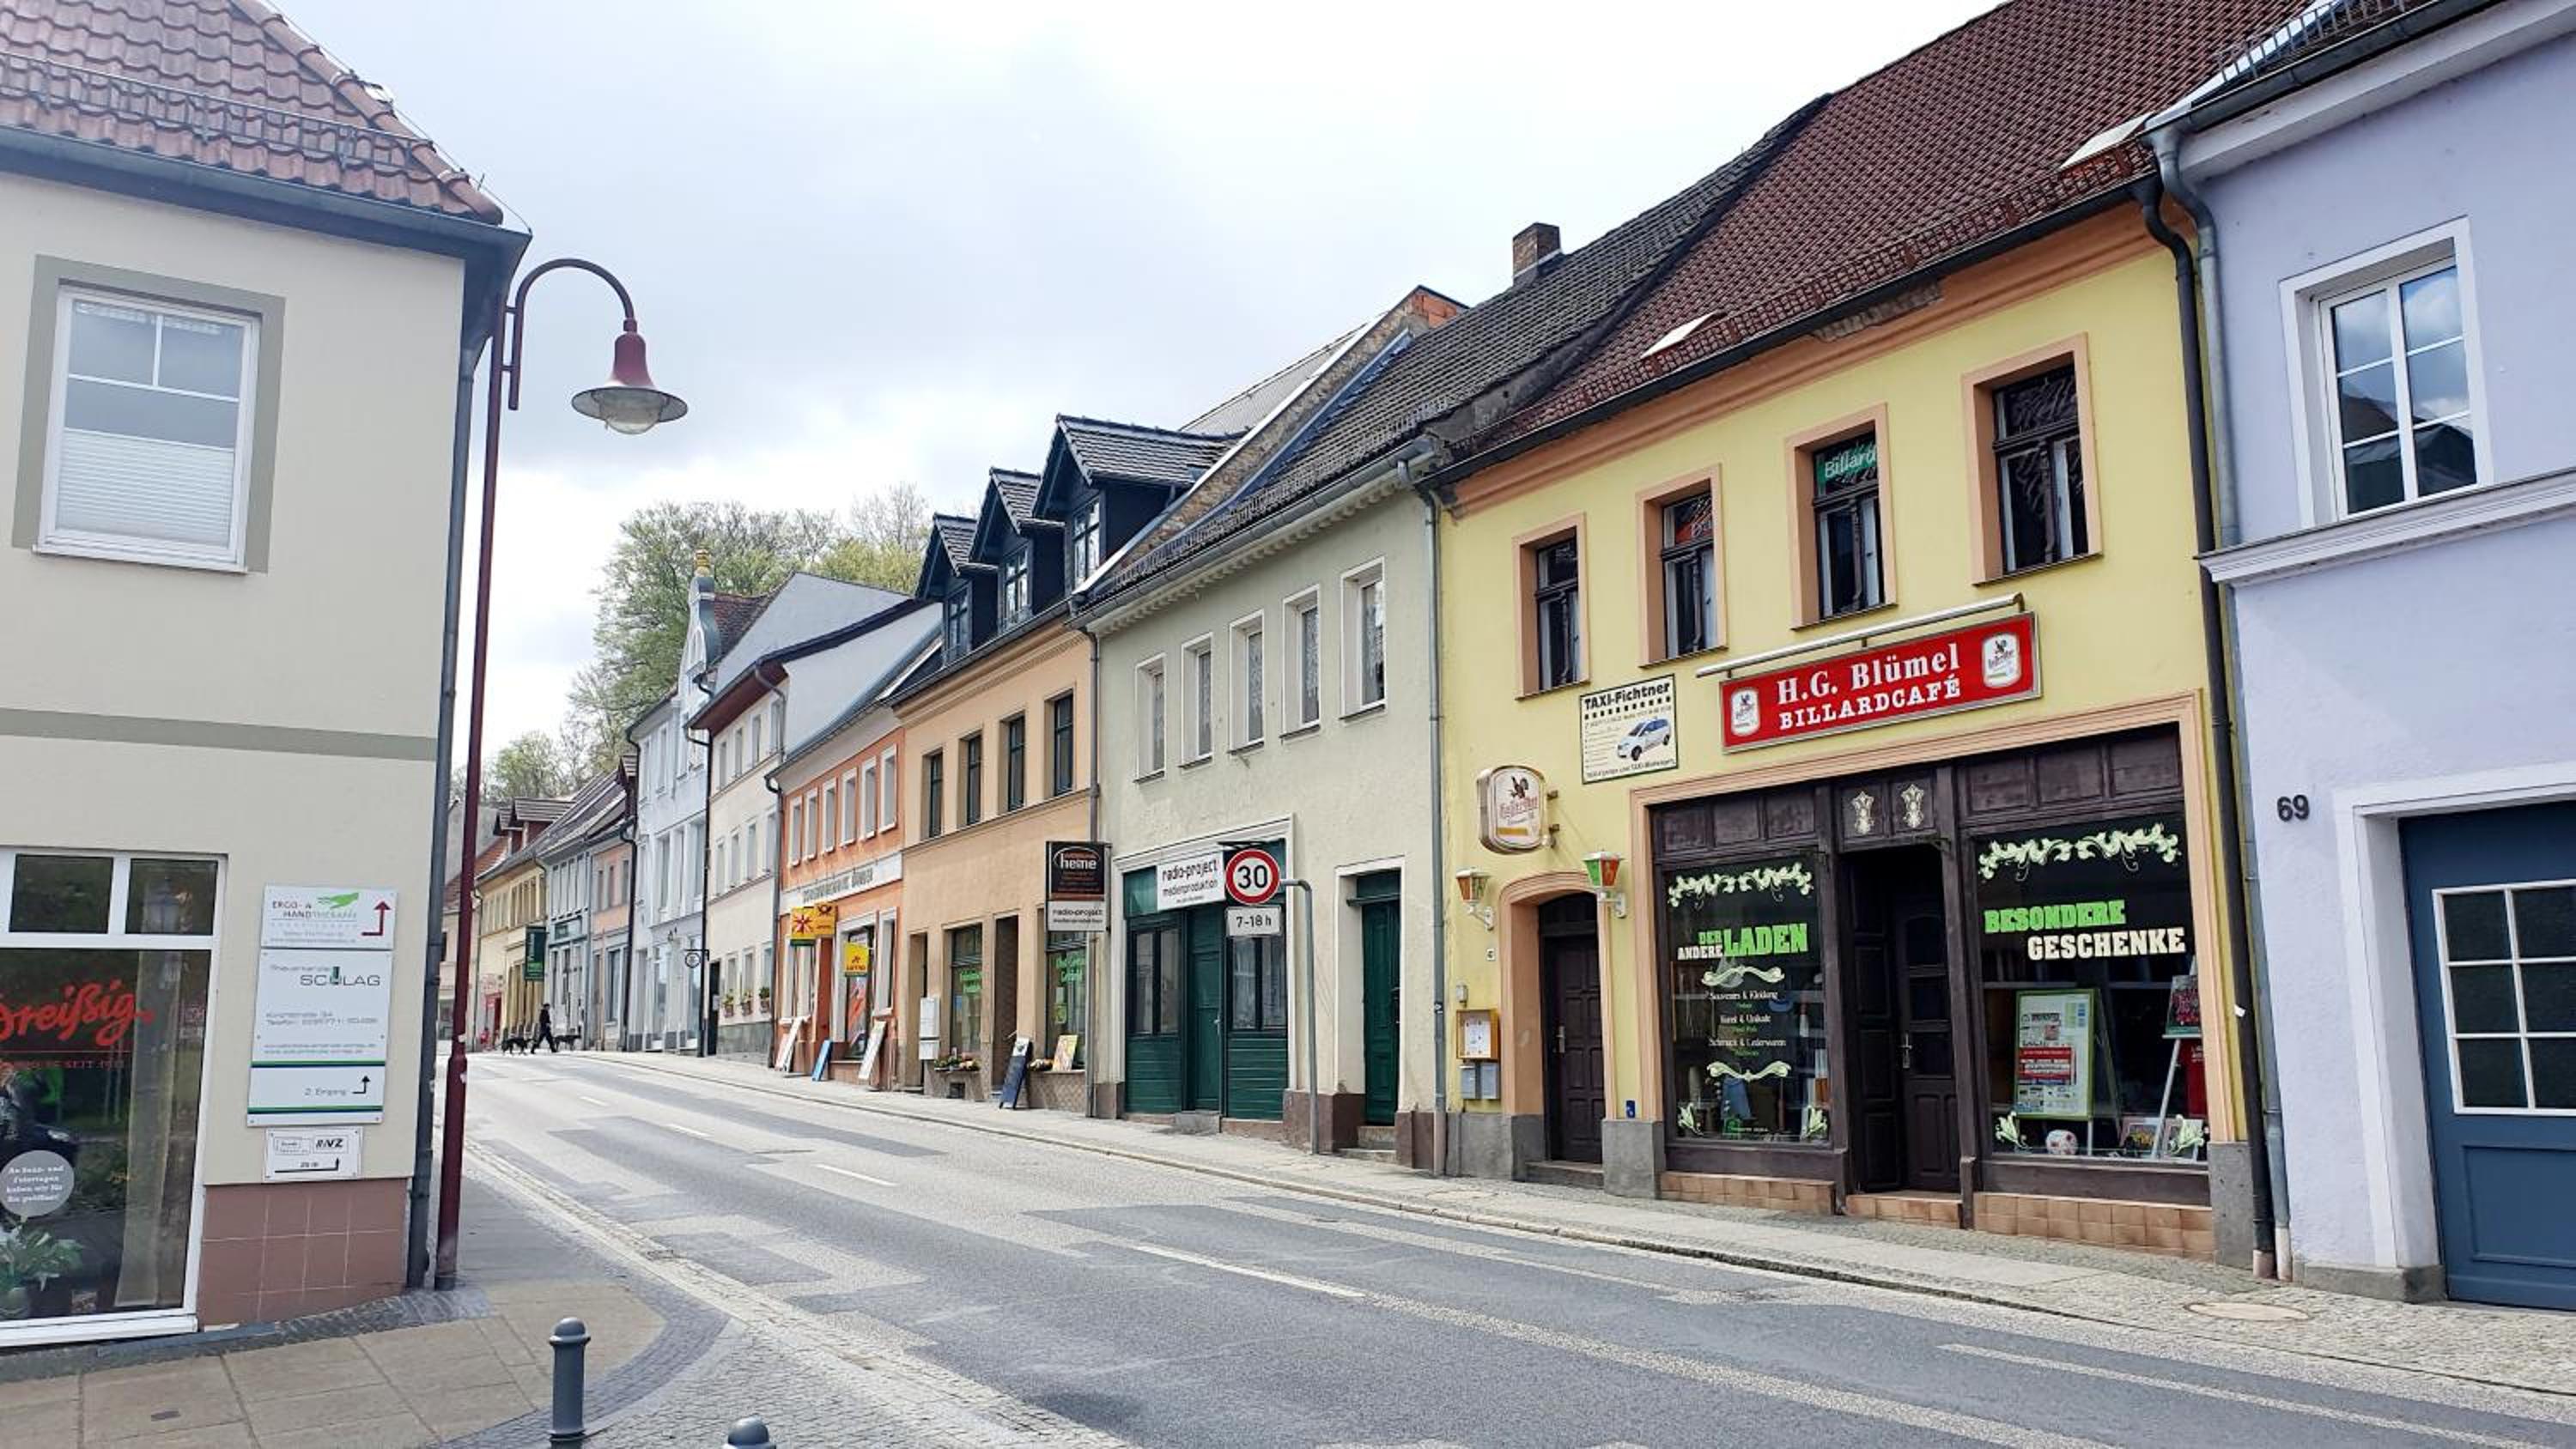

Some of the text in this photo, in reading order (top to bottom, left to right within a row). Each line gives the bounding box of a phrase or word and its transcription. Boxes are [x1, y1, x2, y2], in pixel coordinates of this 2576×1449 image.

[1825, 443, 1877, 478] Billard
[1777, 643, 1961, 705] H.G. Blümel
[1584, 682, 1671, 710] TAXI-Fichtner
[1779, 675, 1961, 730] BILLARDCAFÉ
[2277, 794, 2310, 822] 69
[1162, 859, 1218, 882] radio-project
[1237, 864, 1268, 888] 30
[1265, 914, 1272, 926] h
[1984, 900, 2126, 933] BESONDERE
[1698, 930, 1722, 945] DER
[1723, 923, 1808, 957] LADEN
[2027, 927, 2186, 961] GESCHENKE
[1677, 945, 1723, 961] ANDERE
